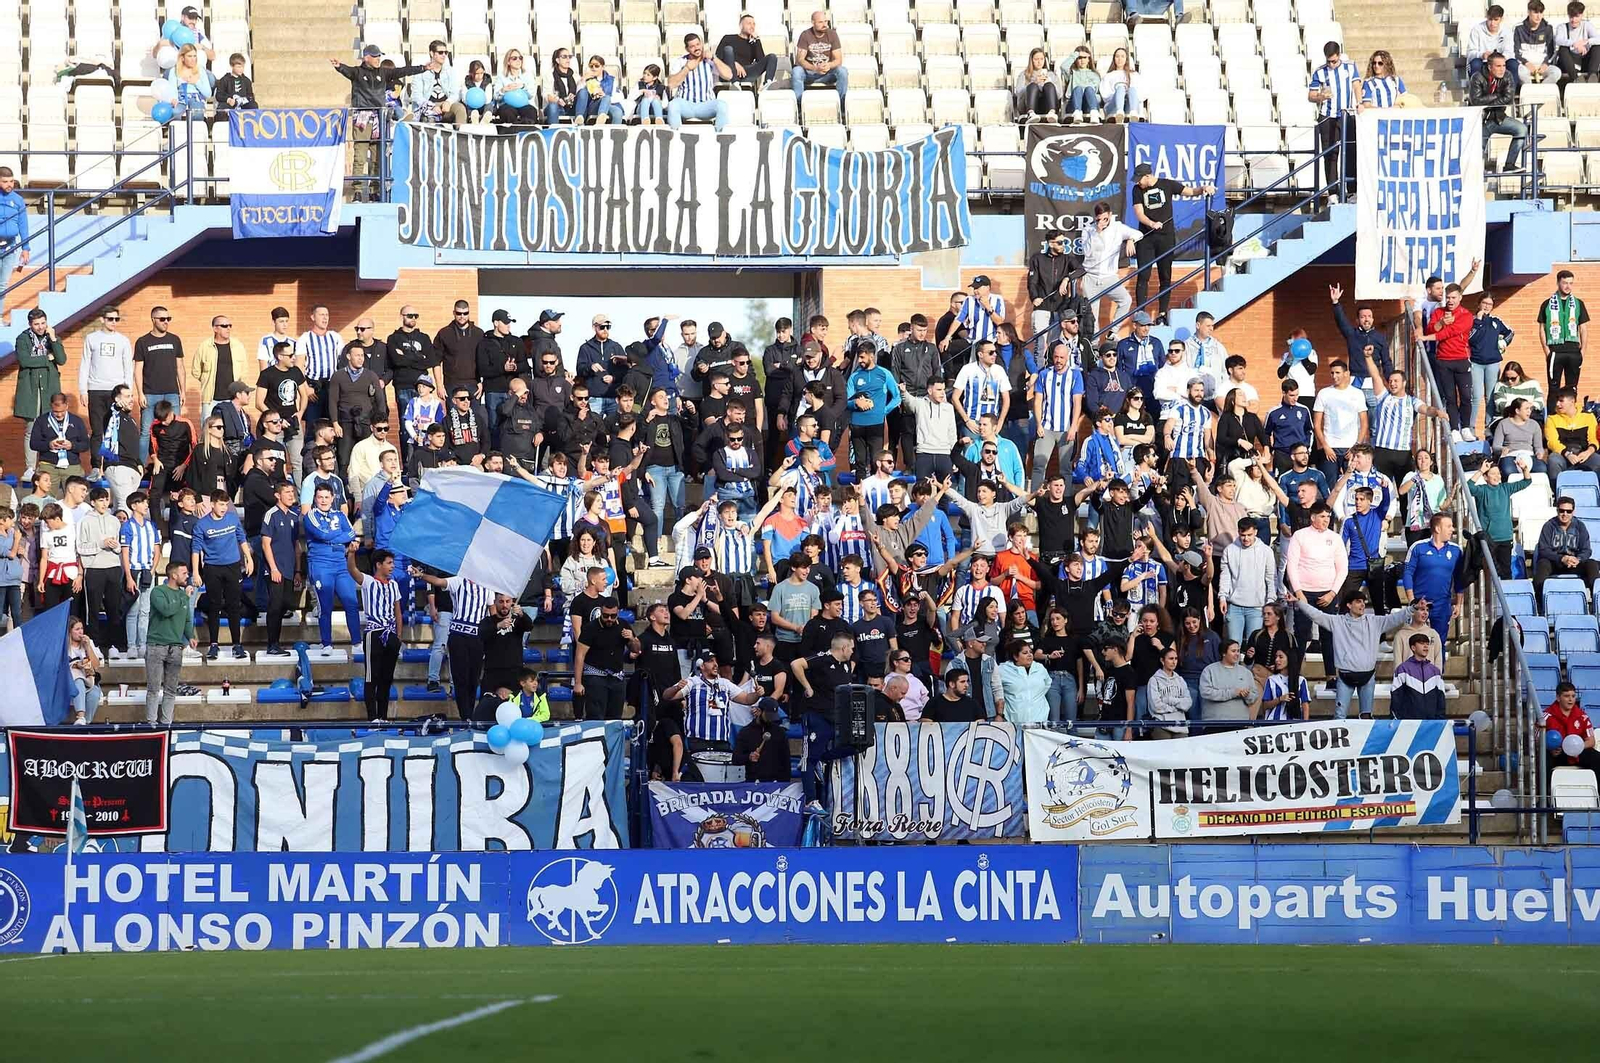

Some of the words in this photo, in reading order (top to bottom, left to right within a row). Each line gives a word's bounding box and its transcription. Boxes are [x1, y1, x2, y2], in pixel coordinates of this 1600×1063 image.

[1377, 118, 1464, 177] RESPETO
[398, 124, 577, 252] JUNTOS
[579, 129, 702, 252] HACIA
[715, 131, 780, 254] LA
[783, 129, 966, 255] GLORIA
[1377, 179, 1421, 230] PARA
[1426, 178, 1463, 230] LOS
[1243, 727, 1350, 756] SECTOR
[24, 758, 153, 780] ABOCREW
[1158, 751, 1443, 805] HELICÓSTERO
[95, 811, 119, 821] 2010
[656, 790, 738, 817] BRIGADA
[741, 790, 802, 814] JOVEN
[1052, 812, 1075, 825] Sector
[1092, 819, 1110, 831] Gol
[1113, 813, 1129, 825] Sur
[1207, 813, 1261, 825] DECANO
[1265, 812, 1290, 823] DEL
[888, 812, 943, 835] Recre
[65, 864, 249, 904] HOTEL
[269, 854, 480, 903] MARTÍN
[633, 872, 885, 925] ATRACCIONES
[898, 871, 943, 922] LA
[954, 869, 1060, 922] CINTA
[1091, 874, 1398, 930] Autoparts
[1428, 877, 1600, 922] Huelv
[40, 914, 272, 953] ALONSO
[293, 904, 500, 951] PINZÓN
